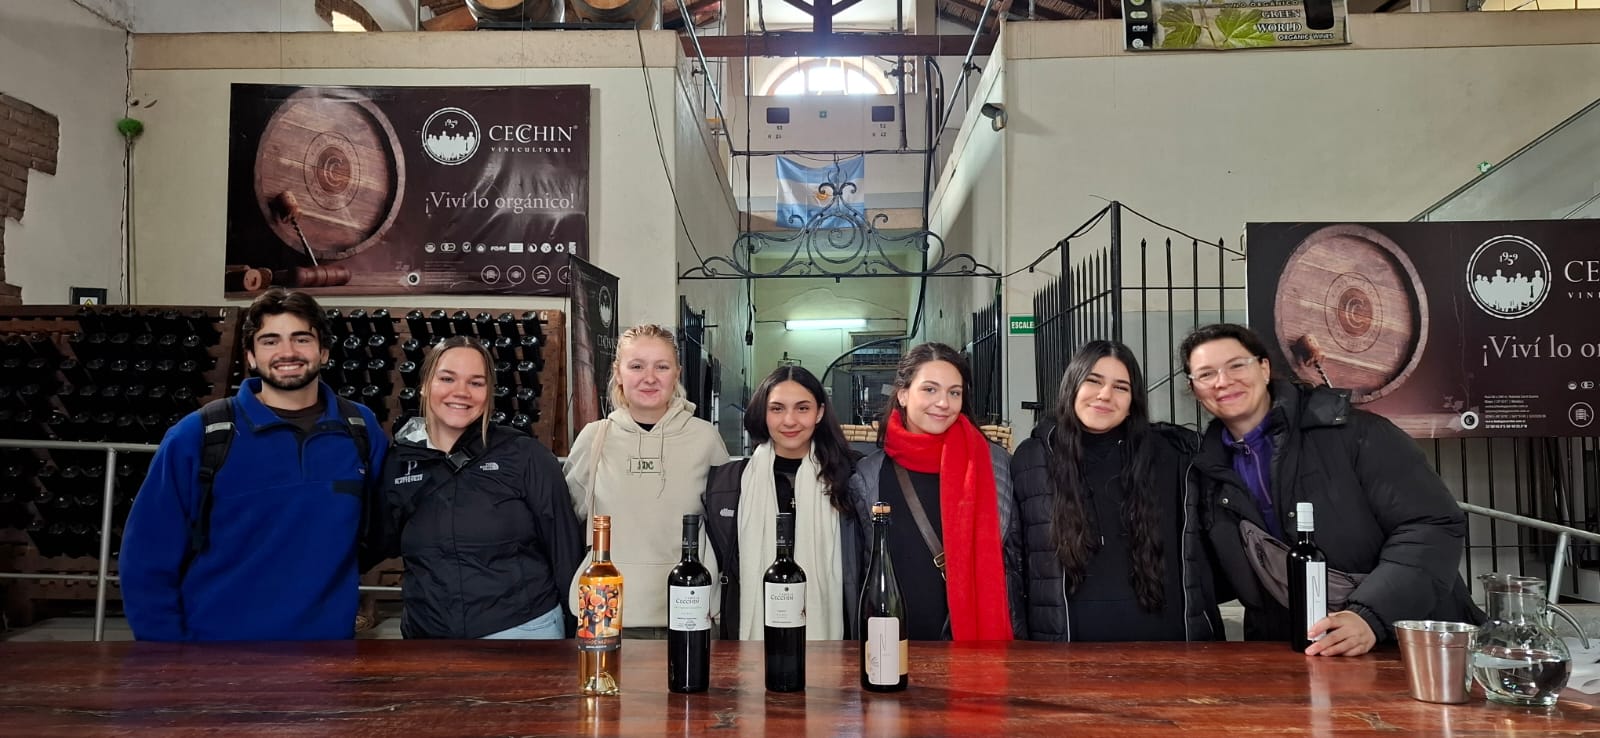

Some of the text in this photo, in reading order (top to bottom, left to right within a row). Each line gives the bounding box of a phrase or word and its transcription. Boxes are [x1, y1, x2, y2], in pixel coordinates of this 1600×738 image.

[1261, 9, 1301, 19] GREEN
[1255, 22, 1303, 33] WORLD
[425, 191, 575, 215] ¡Viví lo orgánico!
[1499, 251, 1519, 266] 1959
[1482, 335, 1541, 367] ¡Viví
[1549, 334, 1571, 358] lo
